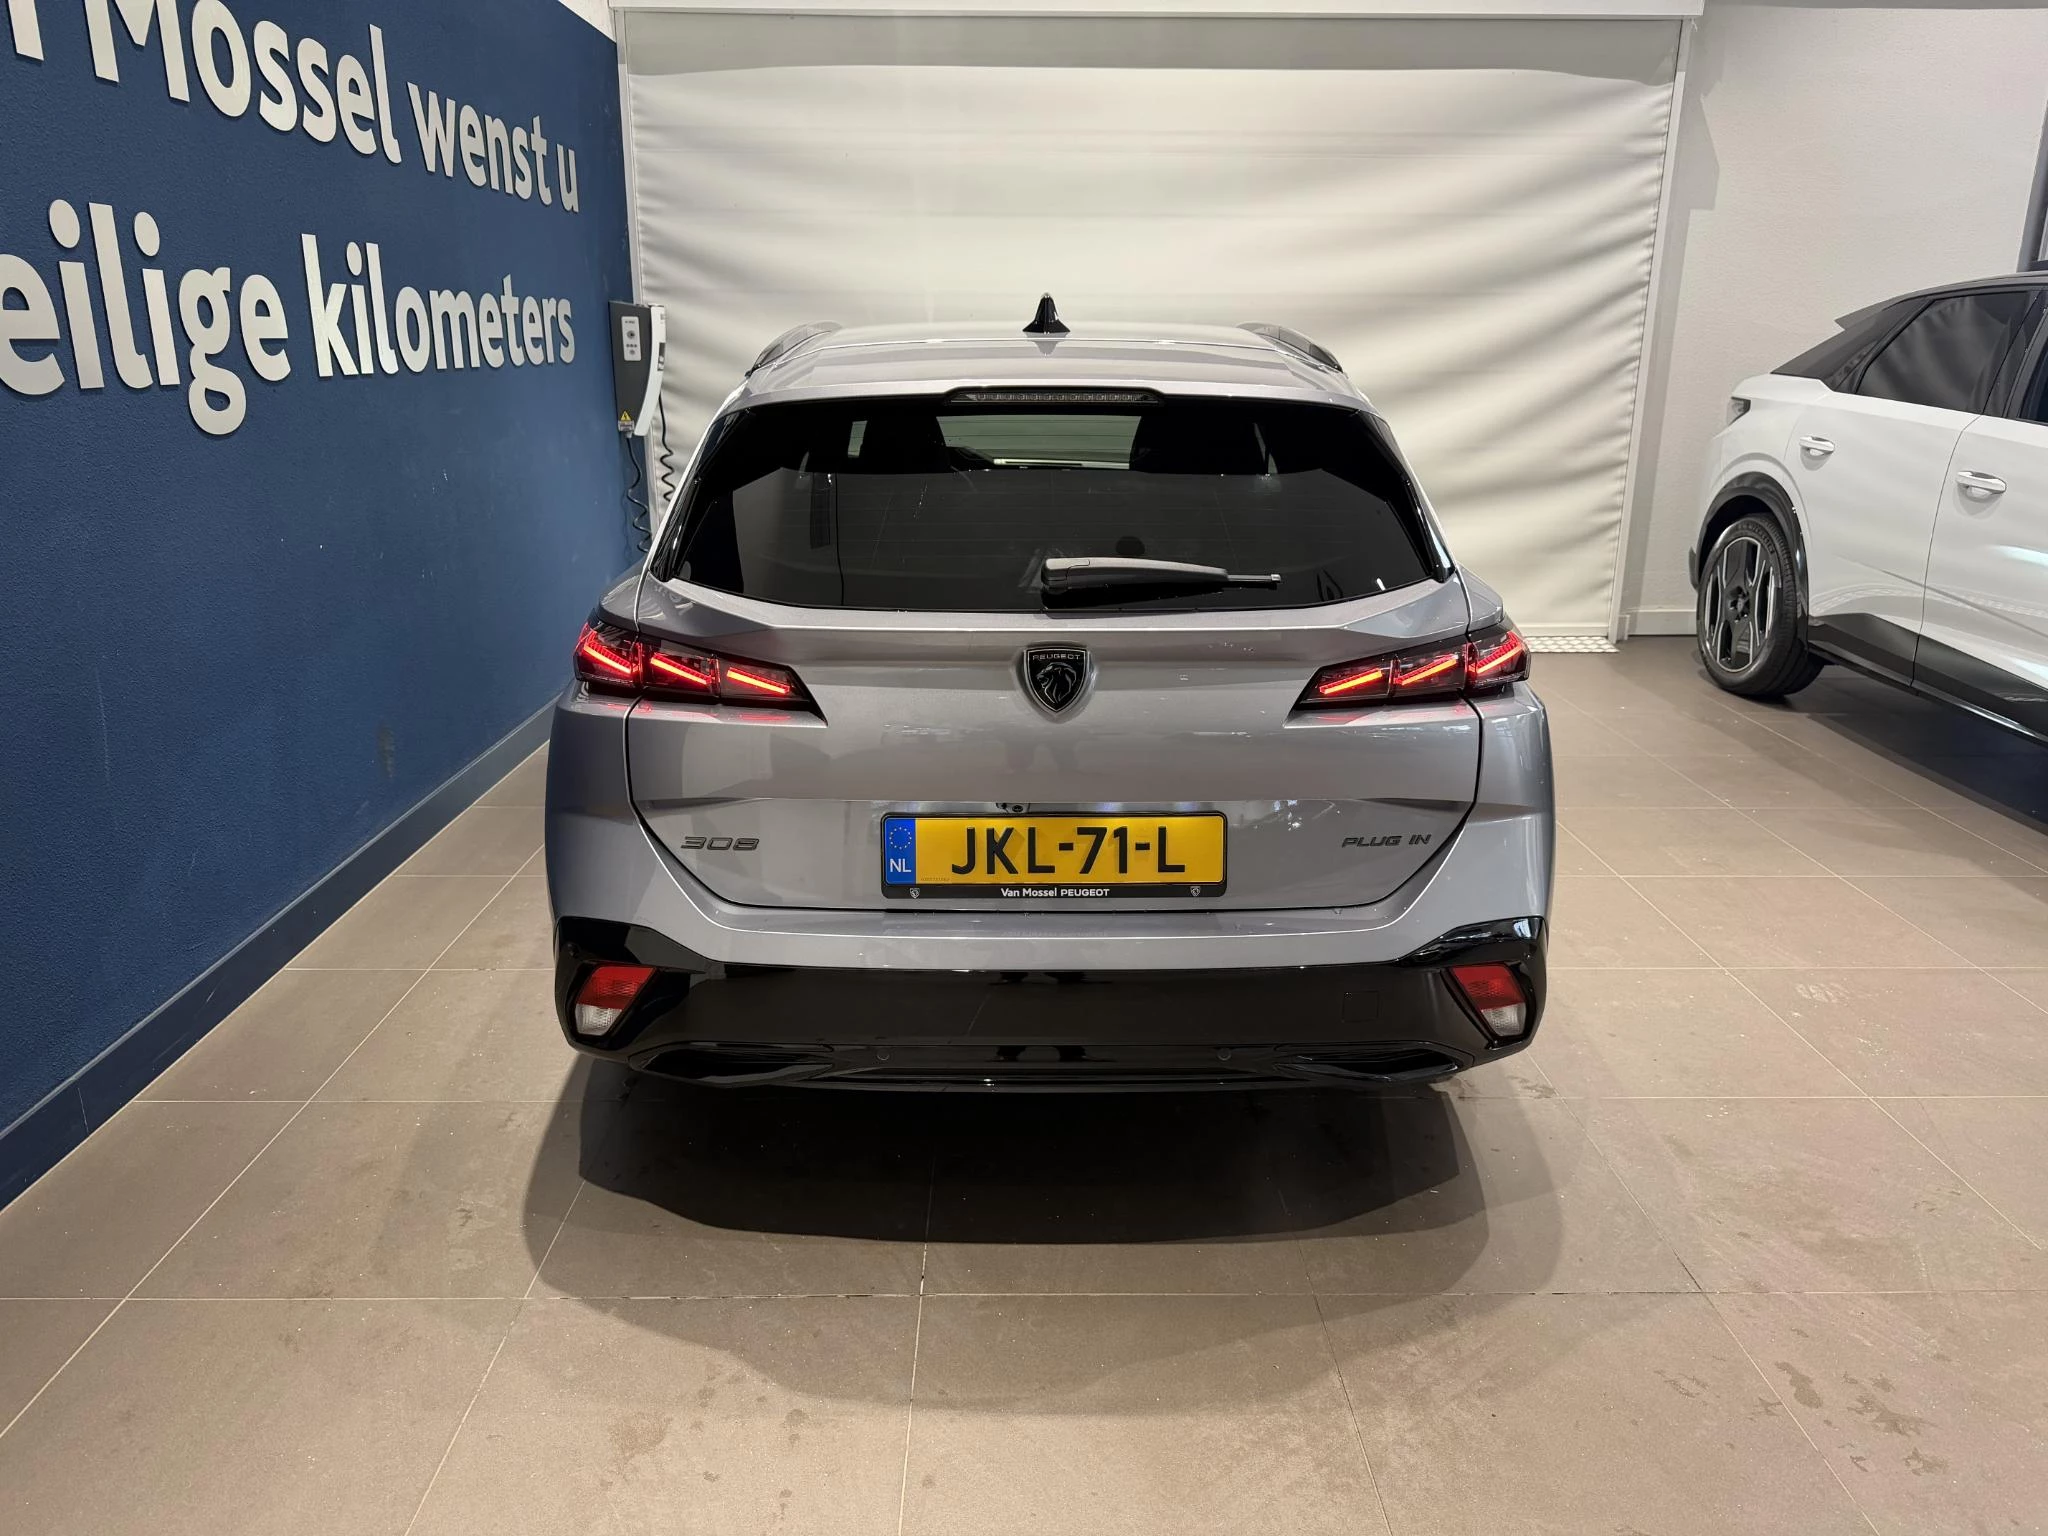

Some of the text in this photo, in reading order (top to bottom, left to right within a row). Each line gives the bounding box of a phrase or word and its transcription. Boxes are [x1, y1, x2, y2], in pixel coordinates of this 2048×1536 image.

[84, 0, 402, 164] Mossel
[407, 82, 552, 205] wenst
[556, 143, 579, 213] u
[301, 233, 576, 378] kilometers
[680, 836, 760, 851] 308
[1341, 834, 1432, 848] PLUG IN
[951, 826, 1185, 874] JKL-71-L
[889, 858, 912, 873] NL
[1000, 887, 1110, 897] Van Mossel PEUGEOT
